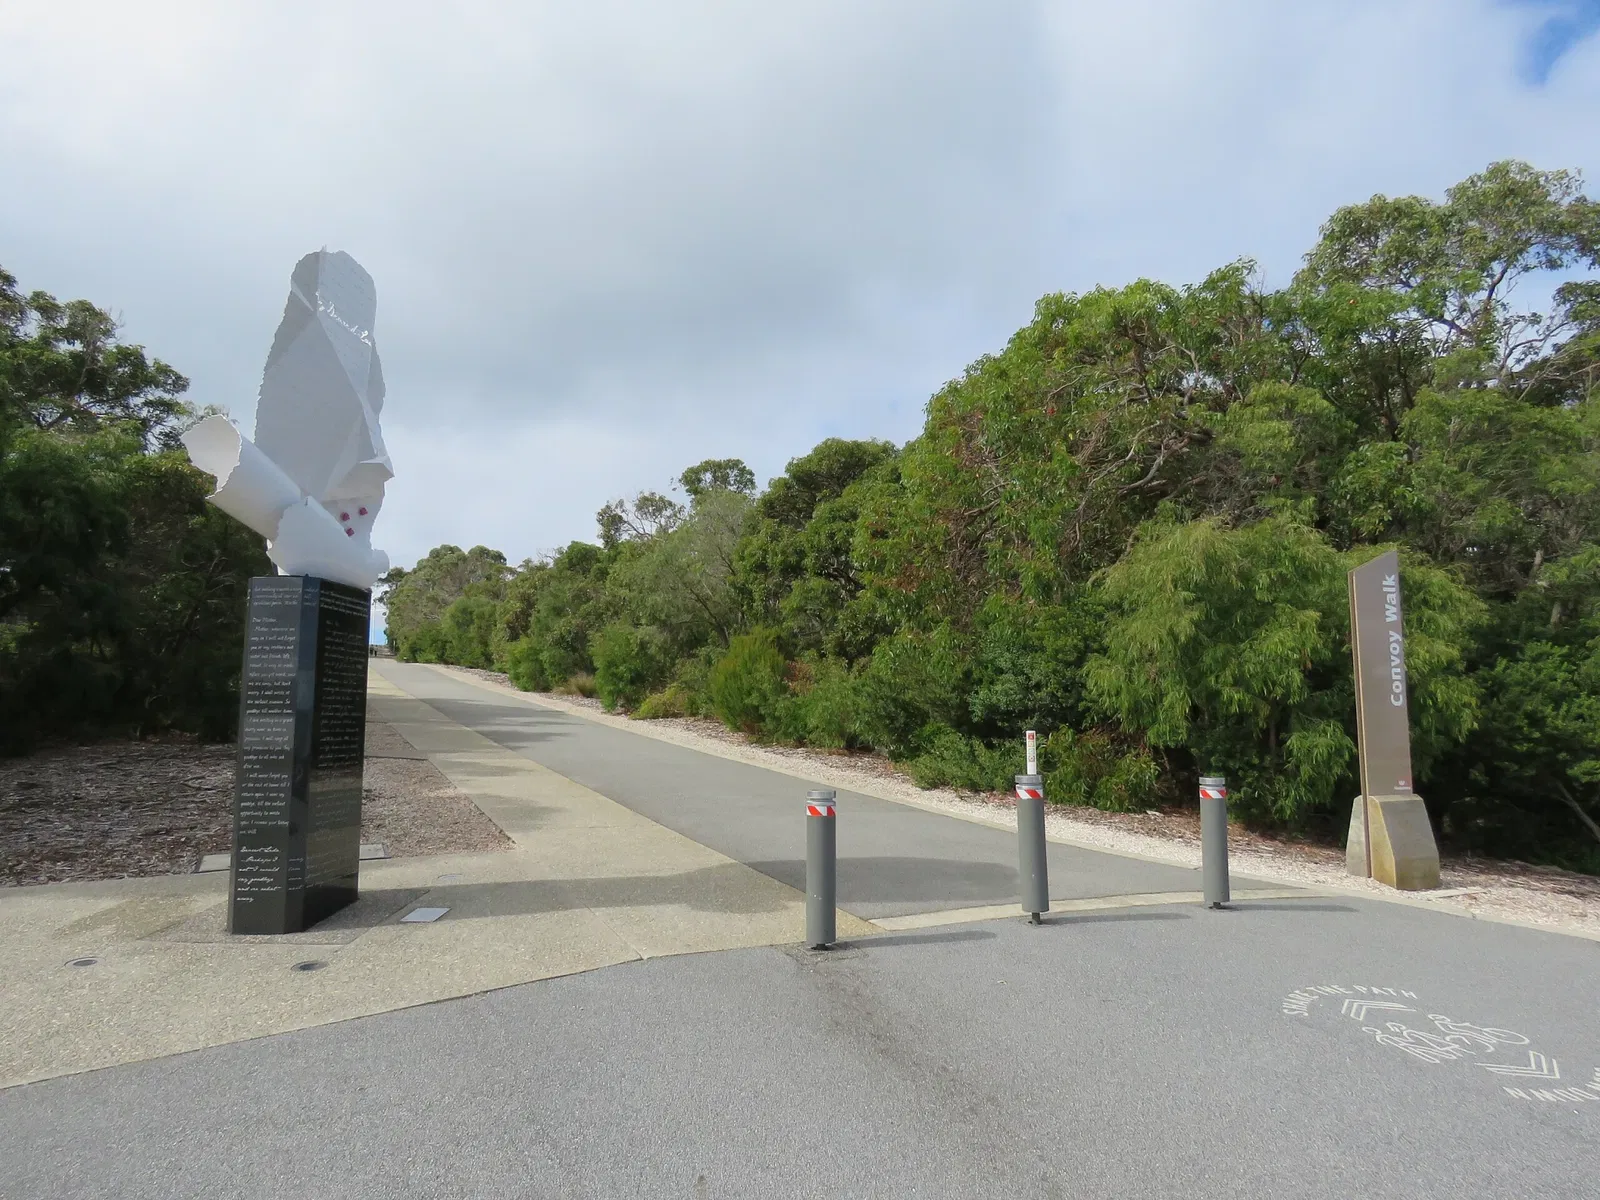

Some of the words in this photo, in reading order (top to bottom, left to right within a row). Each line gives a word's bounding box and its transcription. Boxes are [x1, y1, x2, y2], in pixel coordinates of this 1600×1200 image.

[1382, 573, 1398, 623] Walk
[1389, 630, 1403, 707] Convoy
[1282, 989, 1319, 1016] SHARE
[1305, 984, 1354, 996] THE
[1353, 984, 1418, 1000] PATH
